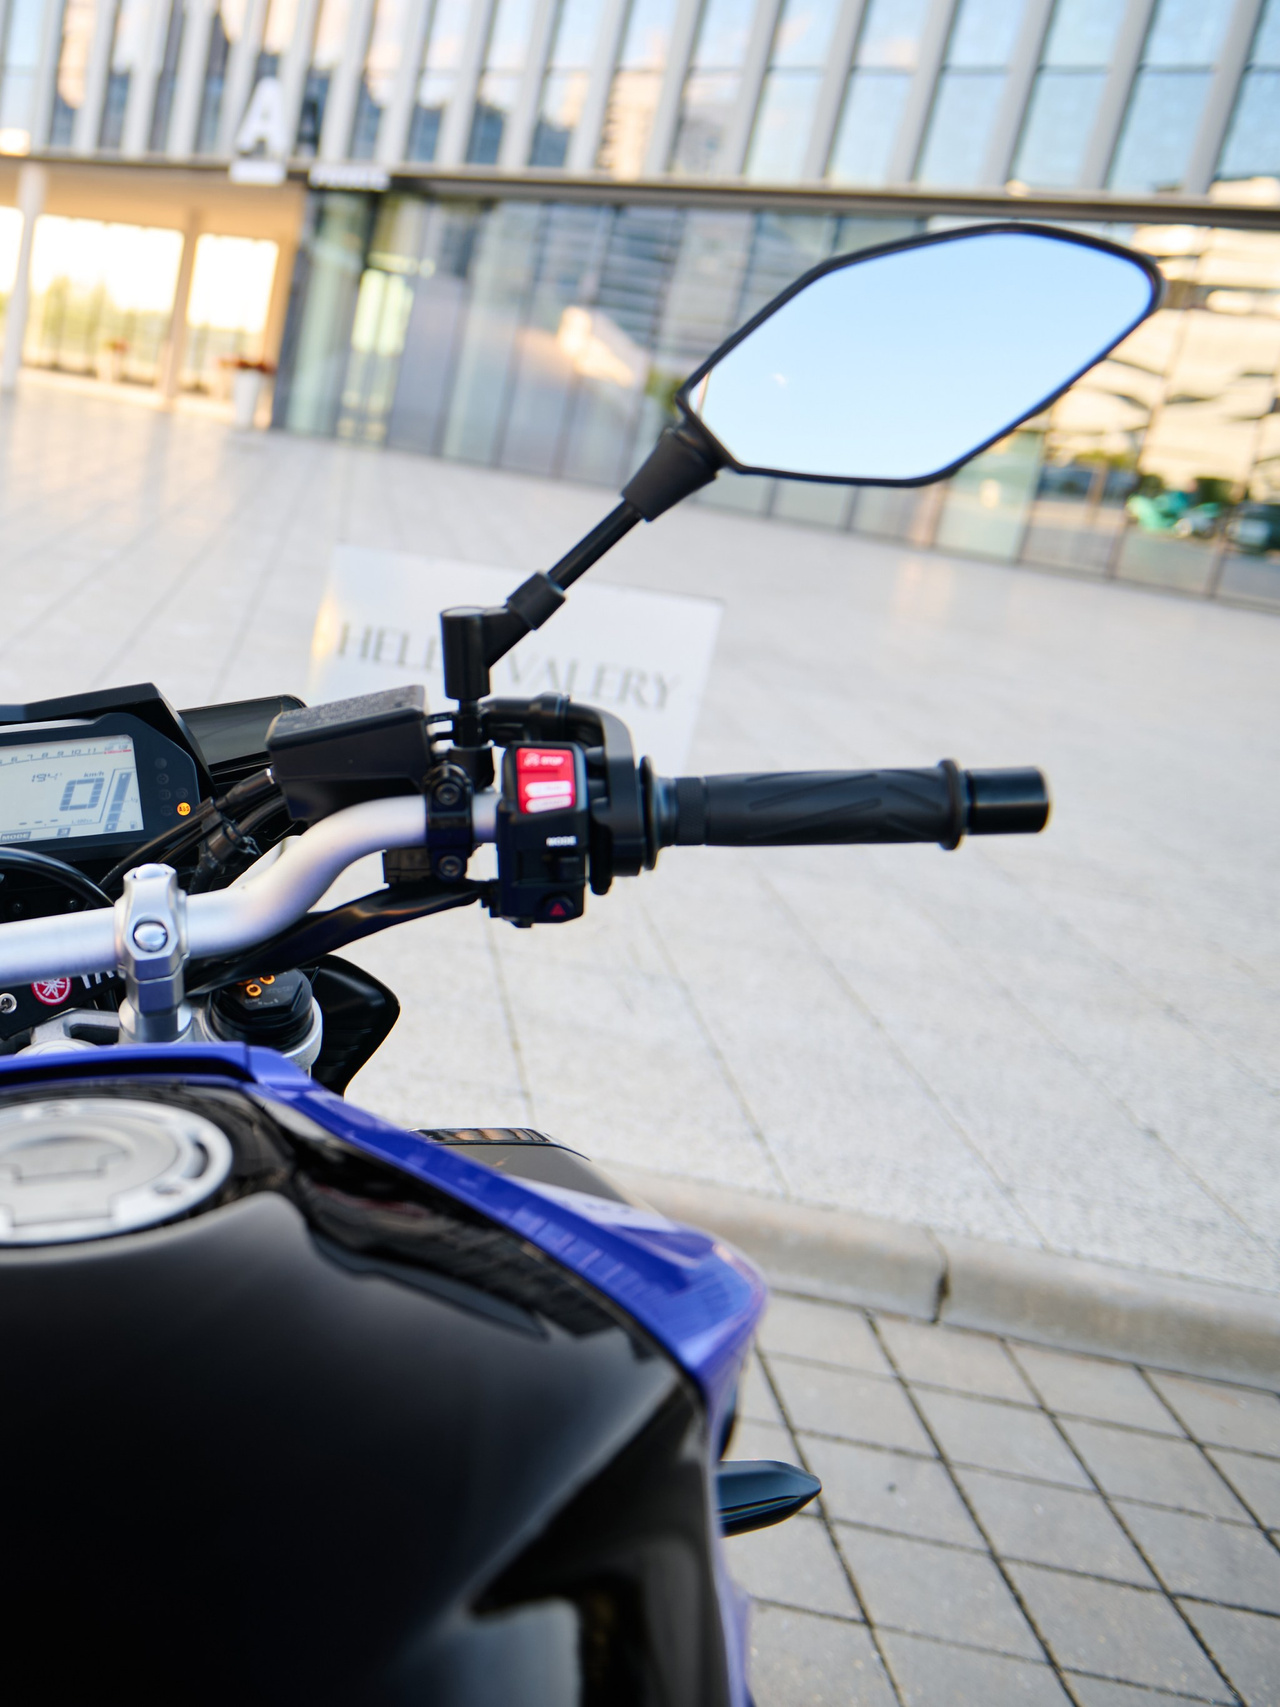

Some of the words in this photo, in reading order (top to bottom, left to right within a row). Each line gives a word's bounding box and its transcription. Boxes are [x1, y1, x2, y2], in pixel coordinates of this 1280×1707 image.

[336, 620, 442, 674] HELL
[507, 650, 681, 713] VALERY
[545, 835, 577, 847] MODE
